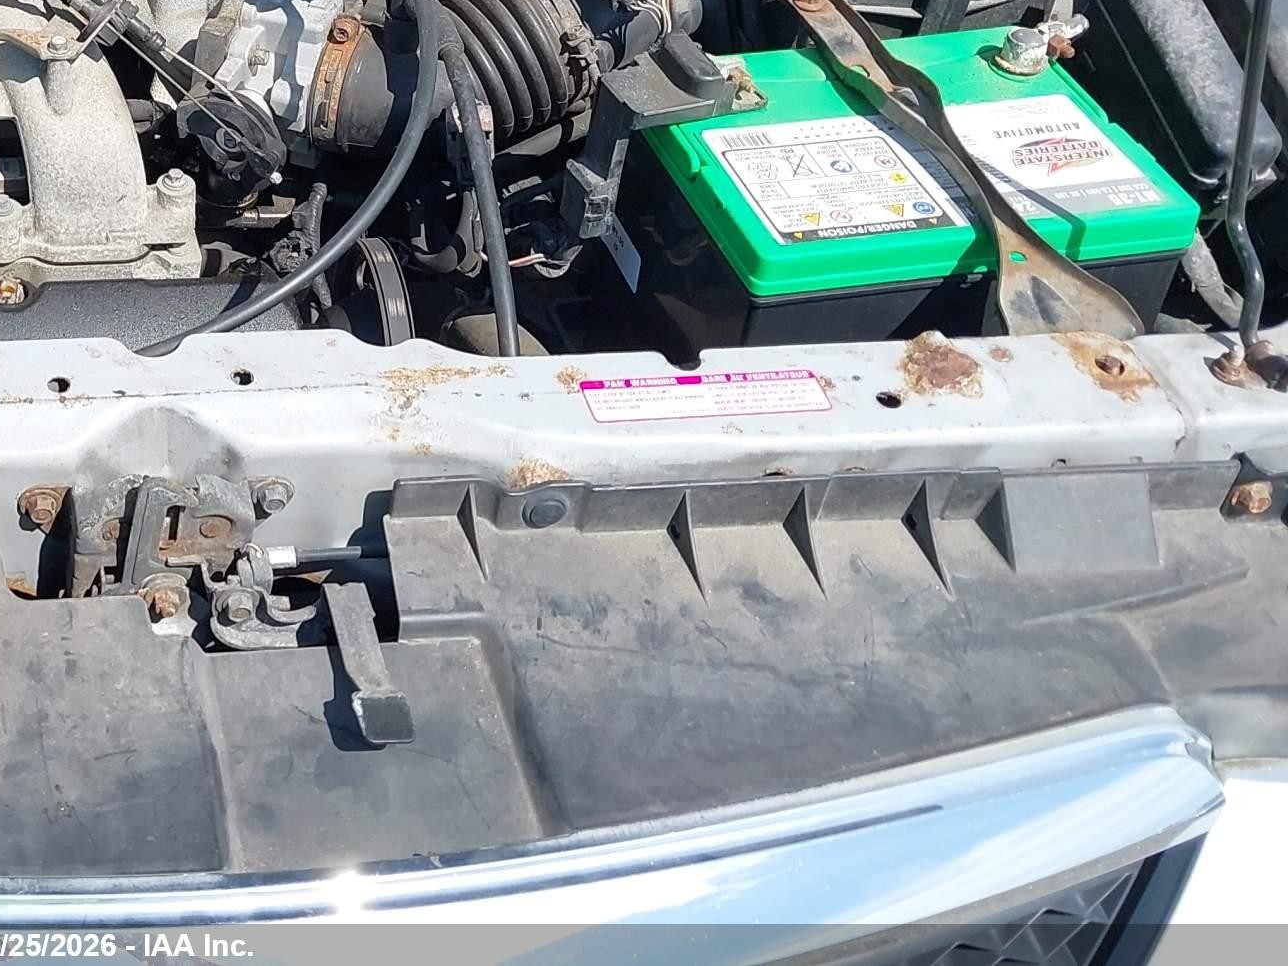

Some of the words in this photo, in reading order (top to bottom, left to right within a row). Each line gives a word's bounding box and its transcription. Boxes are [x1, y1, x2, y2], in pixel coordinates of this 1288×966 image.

[993, 122, 1080, 139] AUTOMOTIVE
[1015, 140, 1101, 157] BATTERIES
[1015, 148, 1110, 166] INTERSTATE
[816, 221, 917, 238] DANGER/POISON
